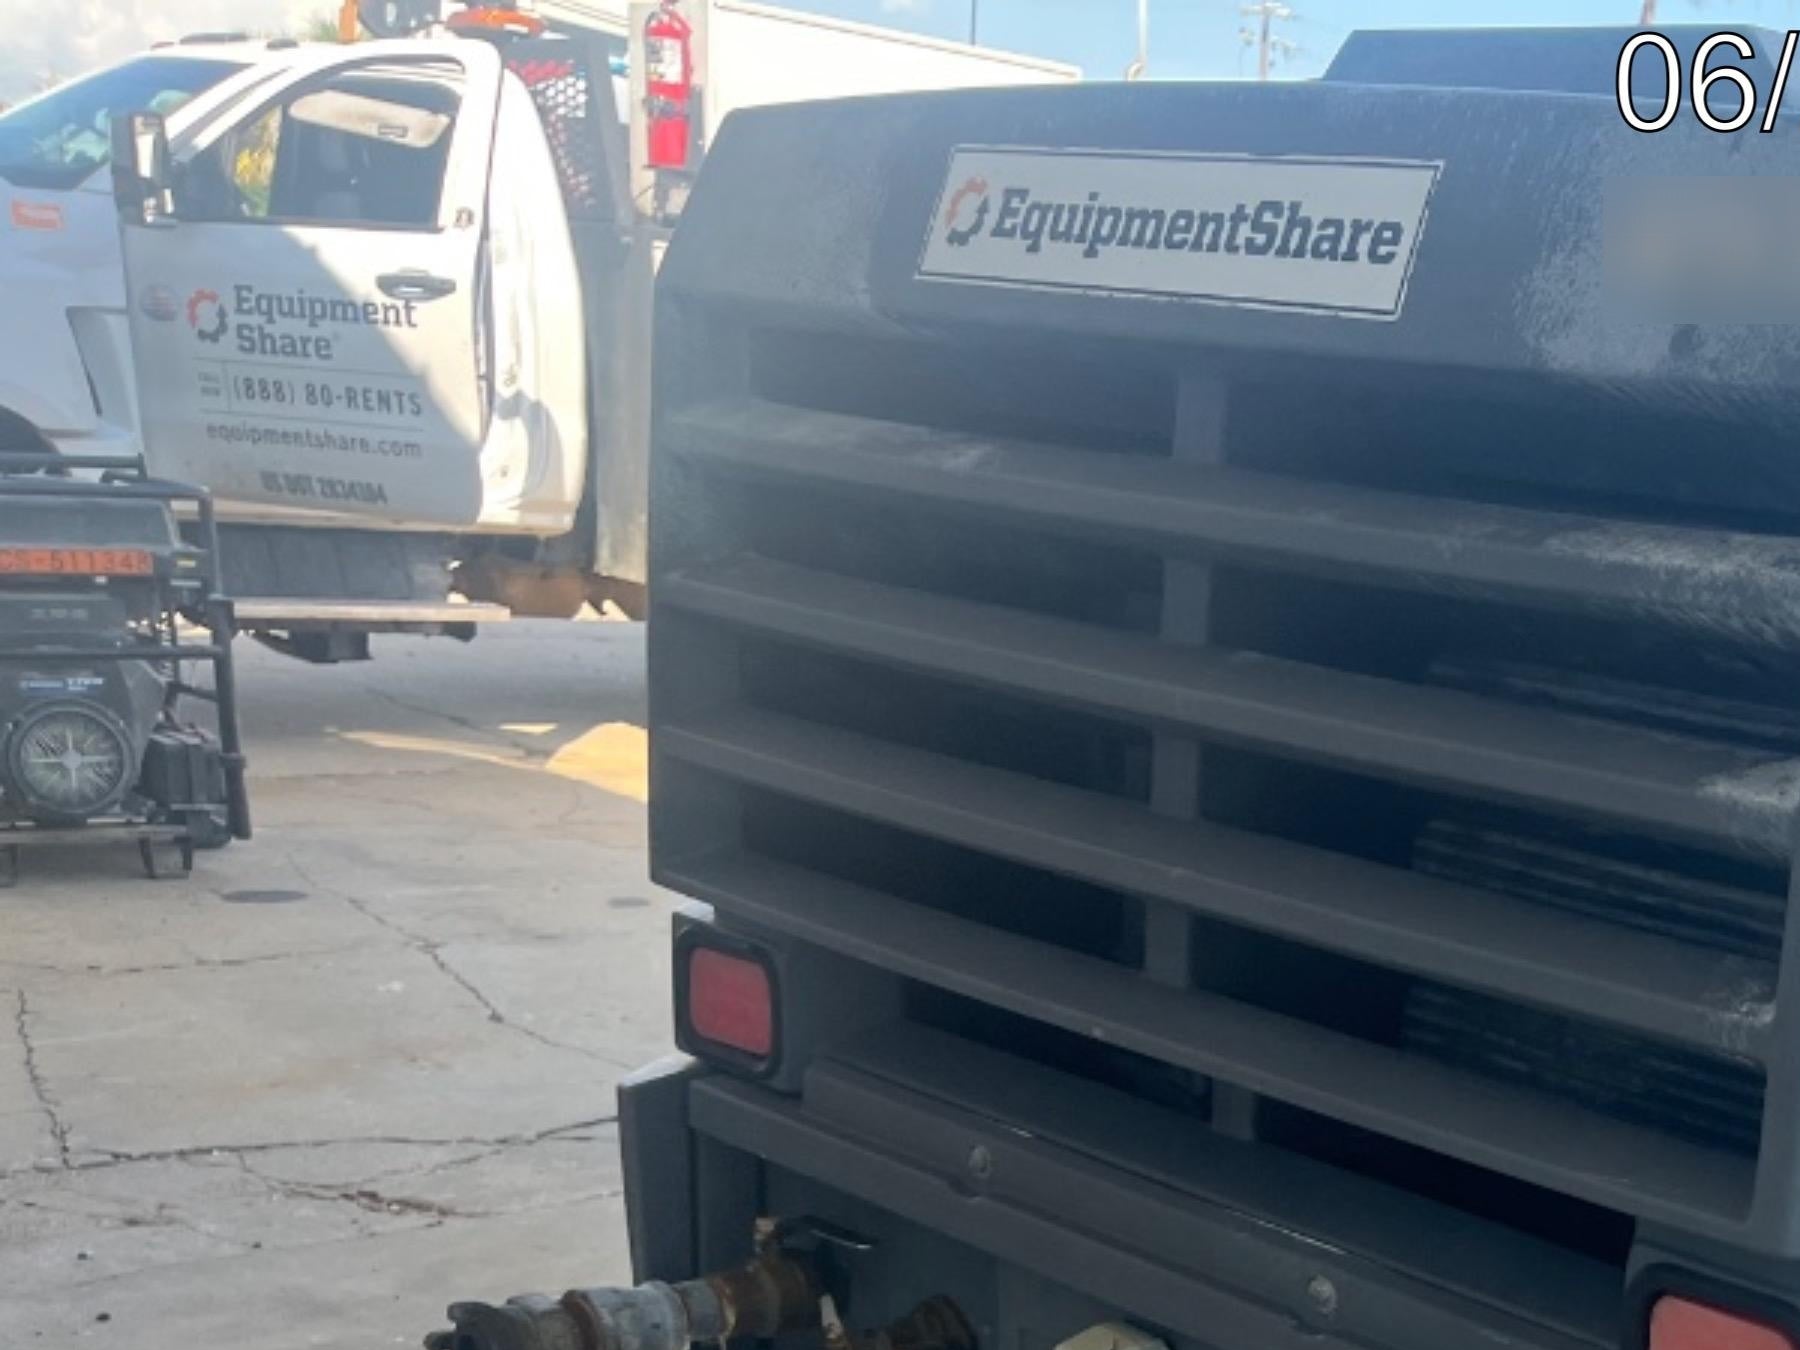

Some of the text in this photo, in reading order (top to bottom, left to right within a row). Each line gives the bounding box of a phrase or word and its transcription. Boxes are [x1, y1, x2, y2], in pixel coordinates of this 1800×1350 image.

[990, 188, 1403, 264] EquipmentShare
[233, 285, 418, 327] Equipment
[236, 325, 333, 361] Share
[232, 376, 296, 406] (888)
[304, 382, 422, 416] 80-RENTS
[206, 423, 422, 457] equipmentshare.com
